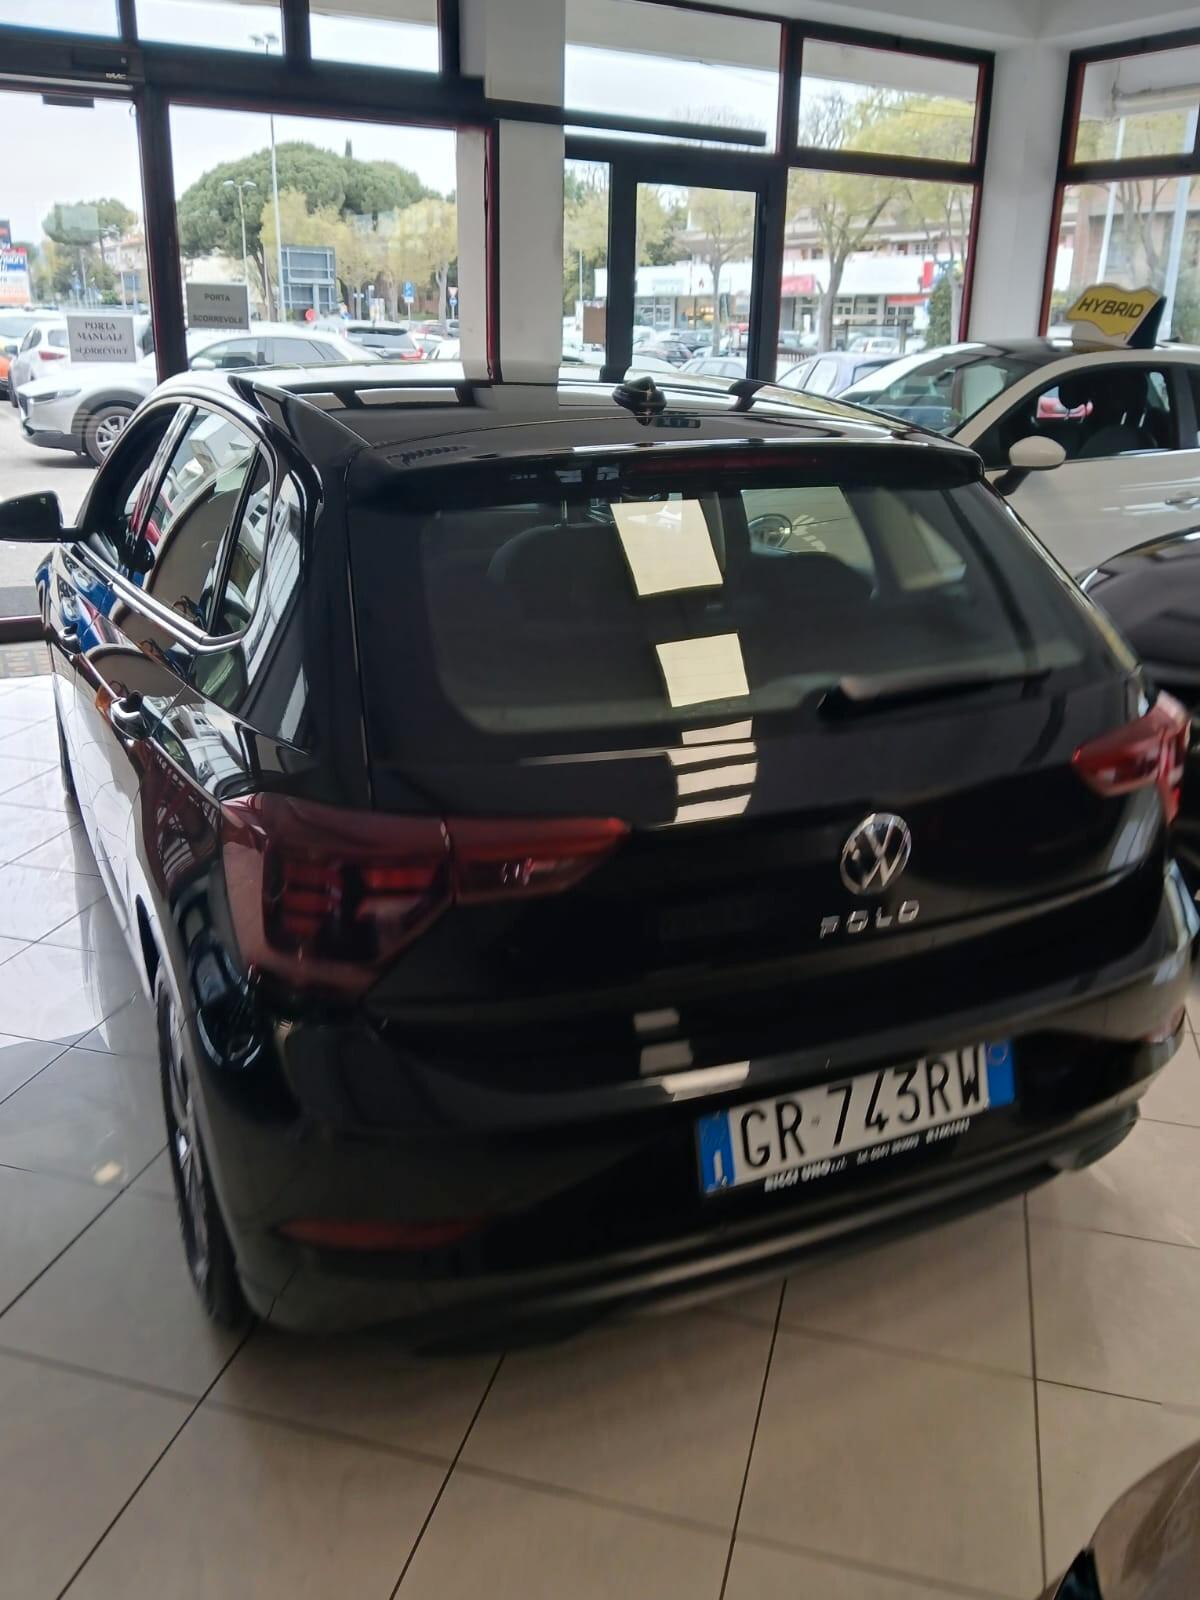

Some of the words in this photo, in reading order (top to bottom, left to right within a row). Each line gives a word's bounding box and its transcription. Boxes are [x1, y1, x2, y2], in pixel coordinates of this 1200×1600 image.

[204, 293, 231, 302] PORTA
[1077, 297, 1144, 318] HYBRID
[85, 321, 116, 330] PORTA
[820, 900, 919, 939] POLO
